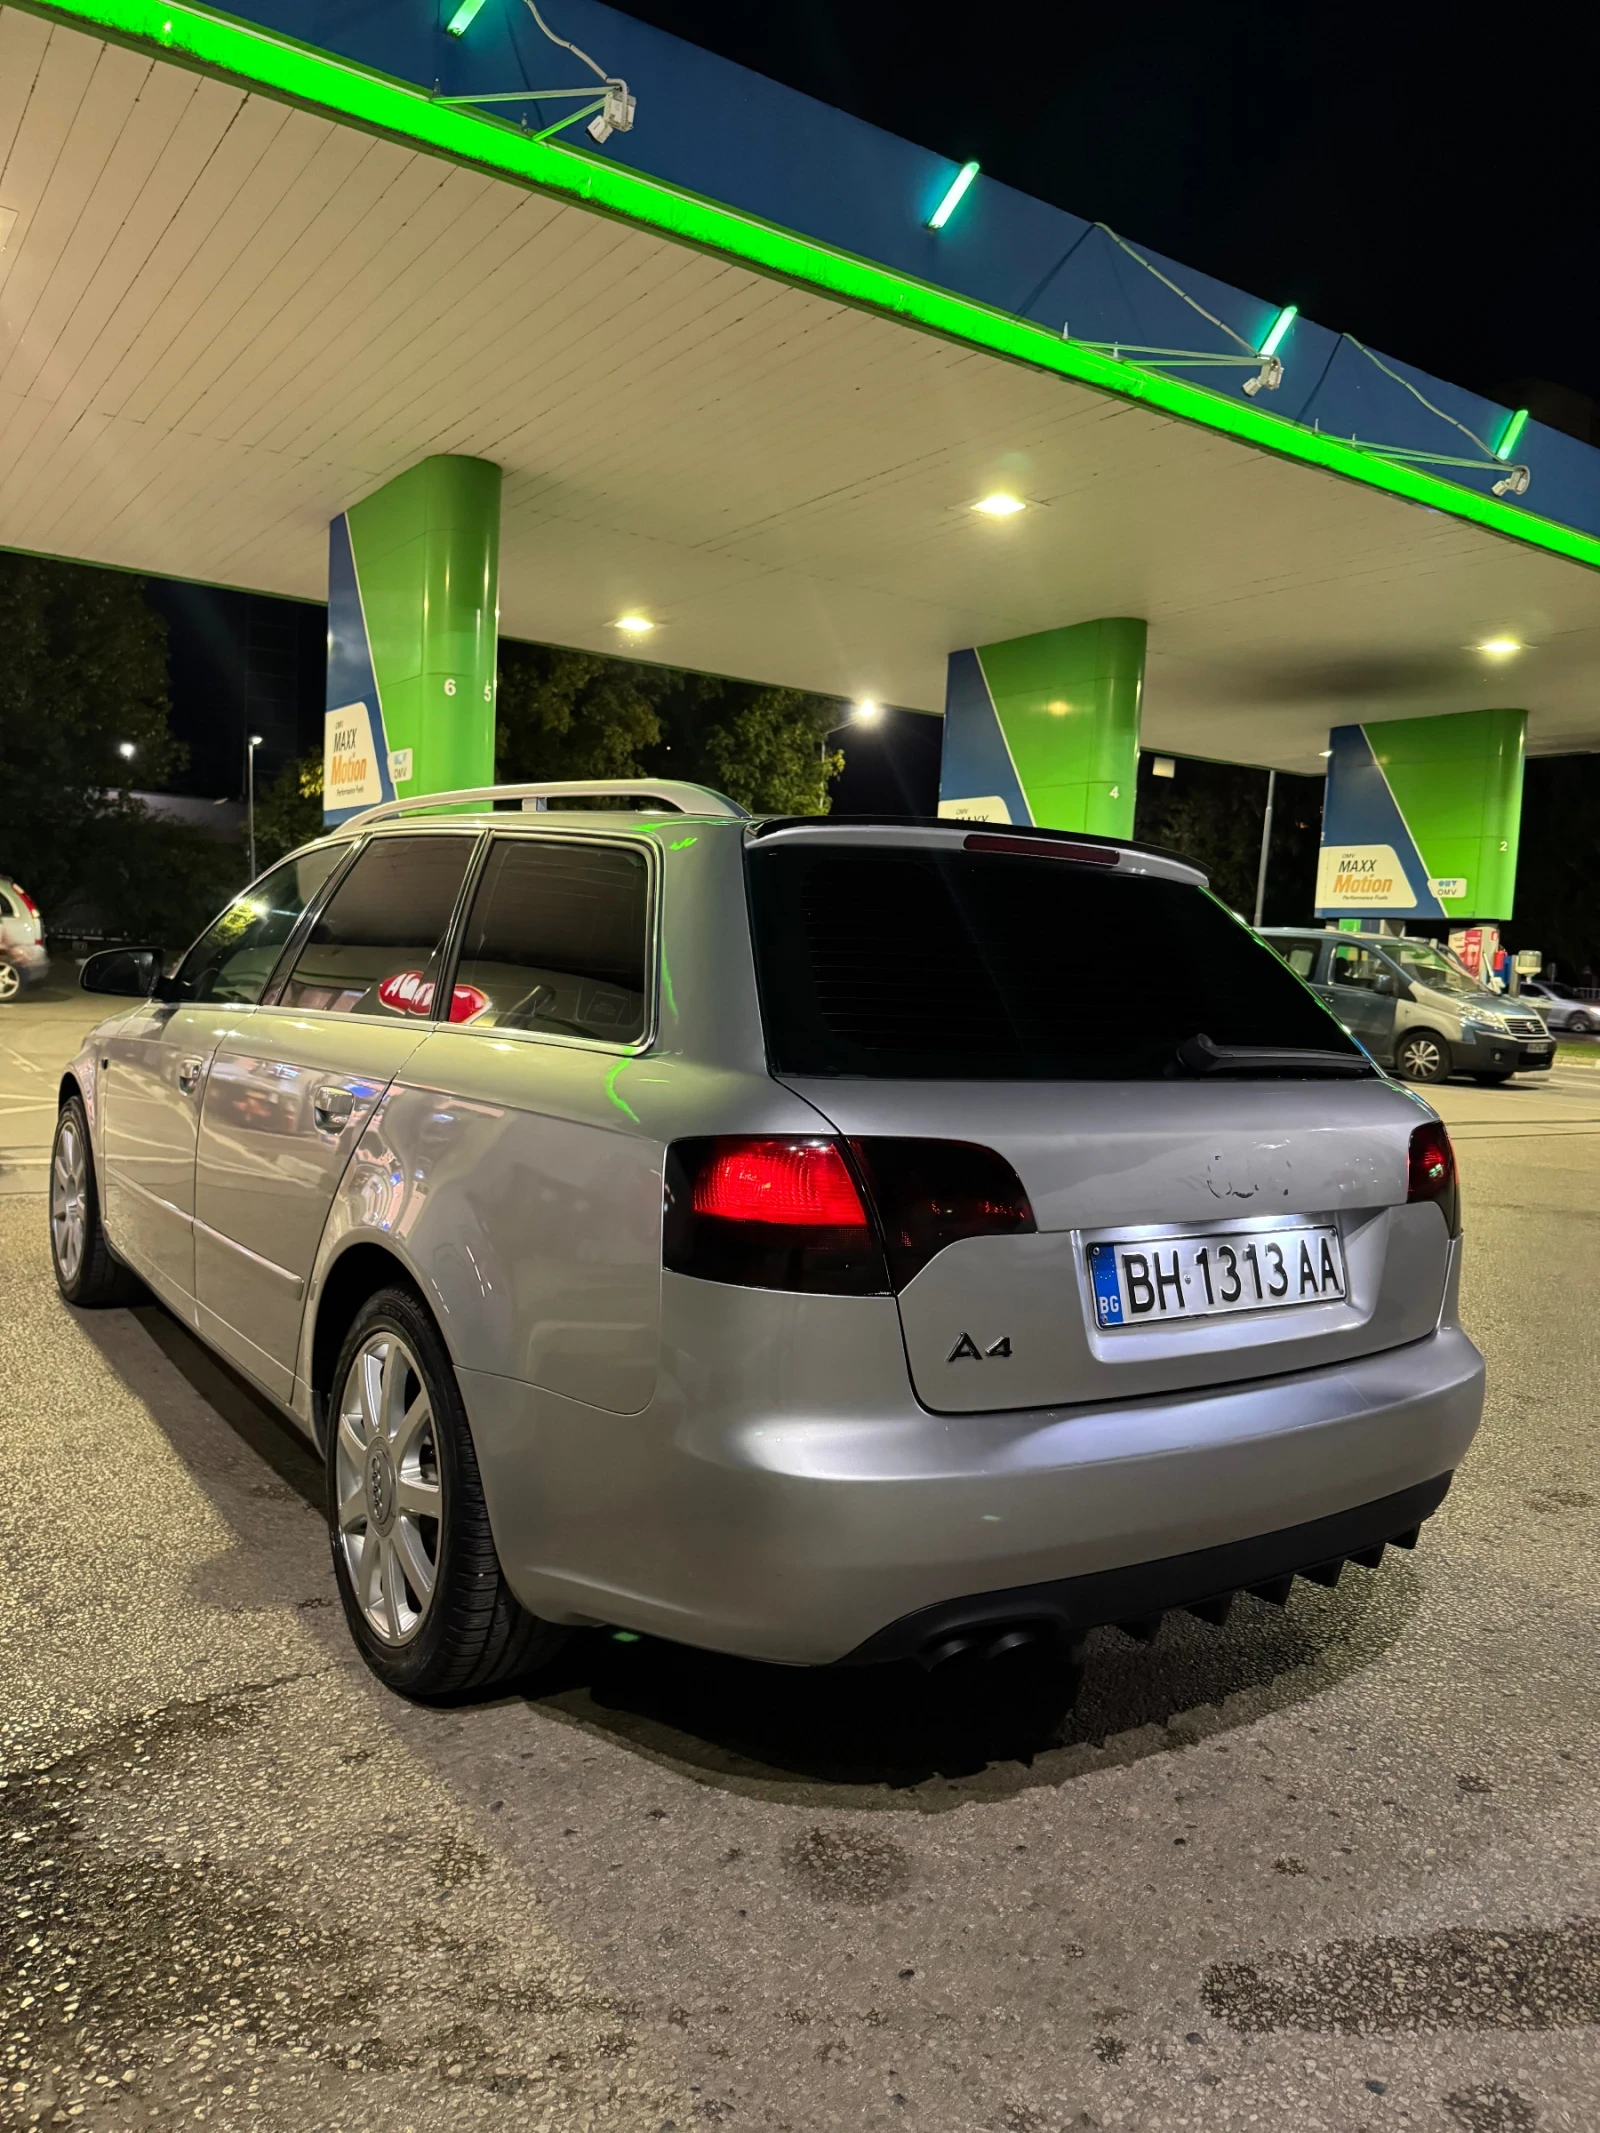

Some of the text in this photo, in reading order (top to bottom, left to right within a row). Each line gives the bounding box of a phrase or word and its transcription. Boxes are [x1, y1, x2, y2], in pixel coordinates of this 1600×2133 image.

[444, 678, 456, 696] 6
[483, 684, 492, 702] 5
[333, 727, 358, 753] MAXX
[330, 752, 367, 786] Motion
[1109, 785, 1119, 799] 4
[1499, 841, 1508, 852] 2
[1338, 859, 1377, 873] MAXX
[1332, 873, 1393, 893] Motion
[1437, 888, 1457, 897] OMV
[1121, 1236, 1341, 1314] BH 1313 AA
[1099, 1294, 1120, 1315] BG
[945, 1332, 1014, 1363] A4
